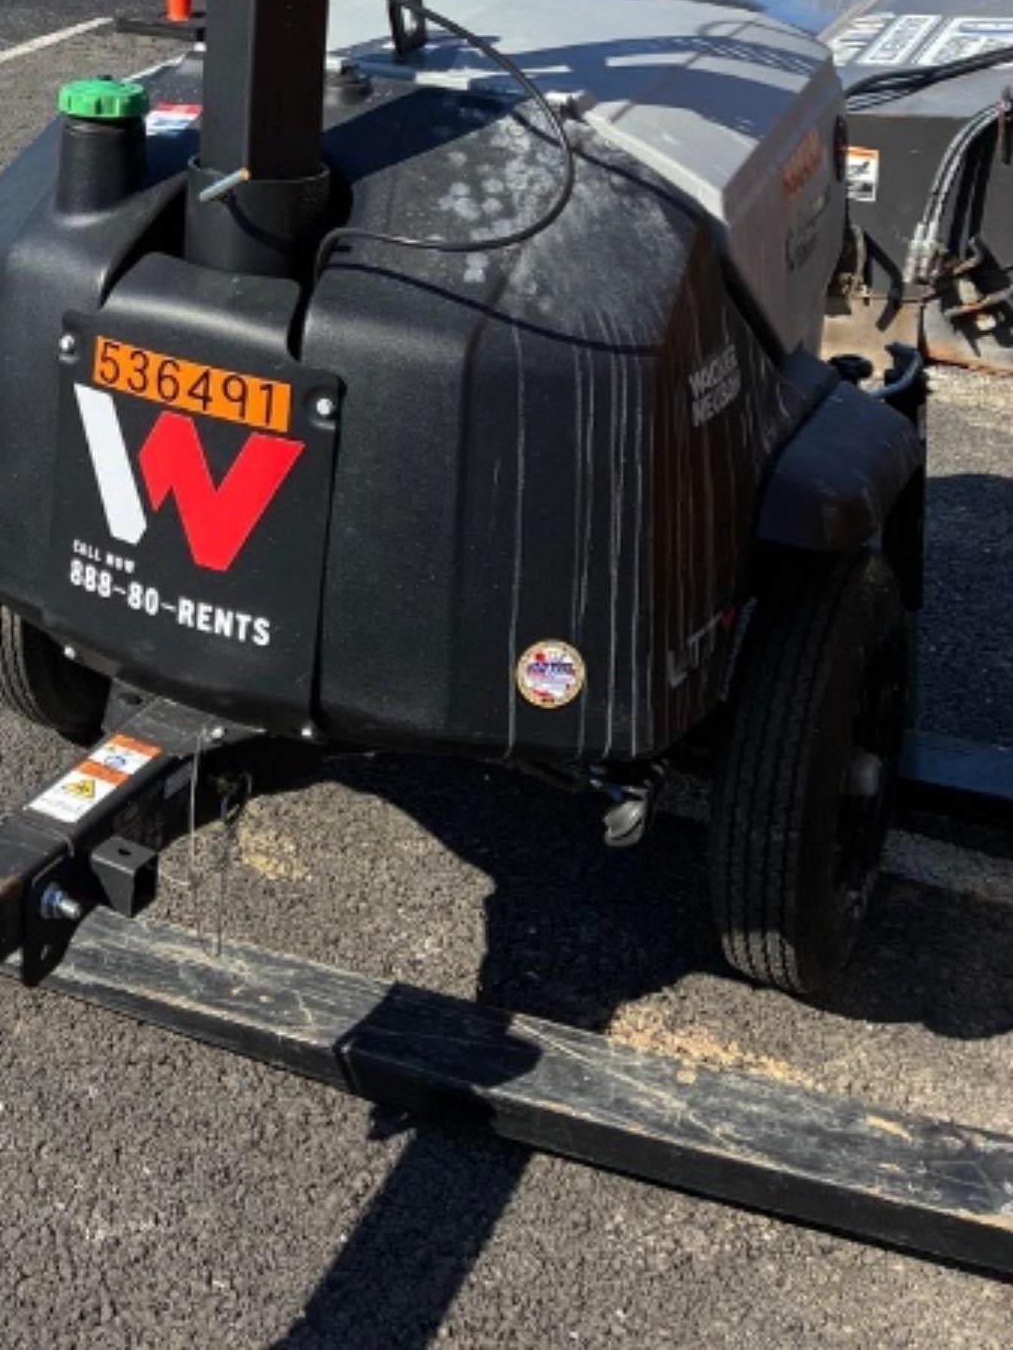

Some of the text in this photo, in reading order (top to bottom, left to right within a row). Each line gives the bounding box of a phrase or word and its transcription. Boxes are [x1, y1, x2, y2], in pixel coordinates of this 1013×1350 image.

[98, 341, 275, 427] 536491
[72, 538, 102, 562] CALL
[69, 557, 272, 647] 888-80-RENTS
